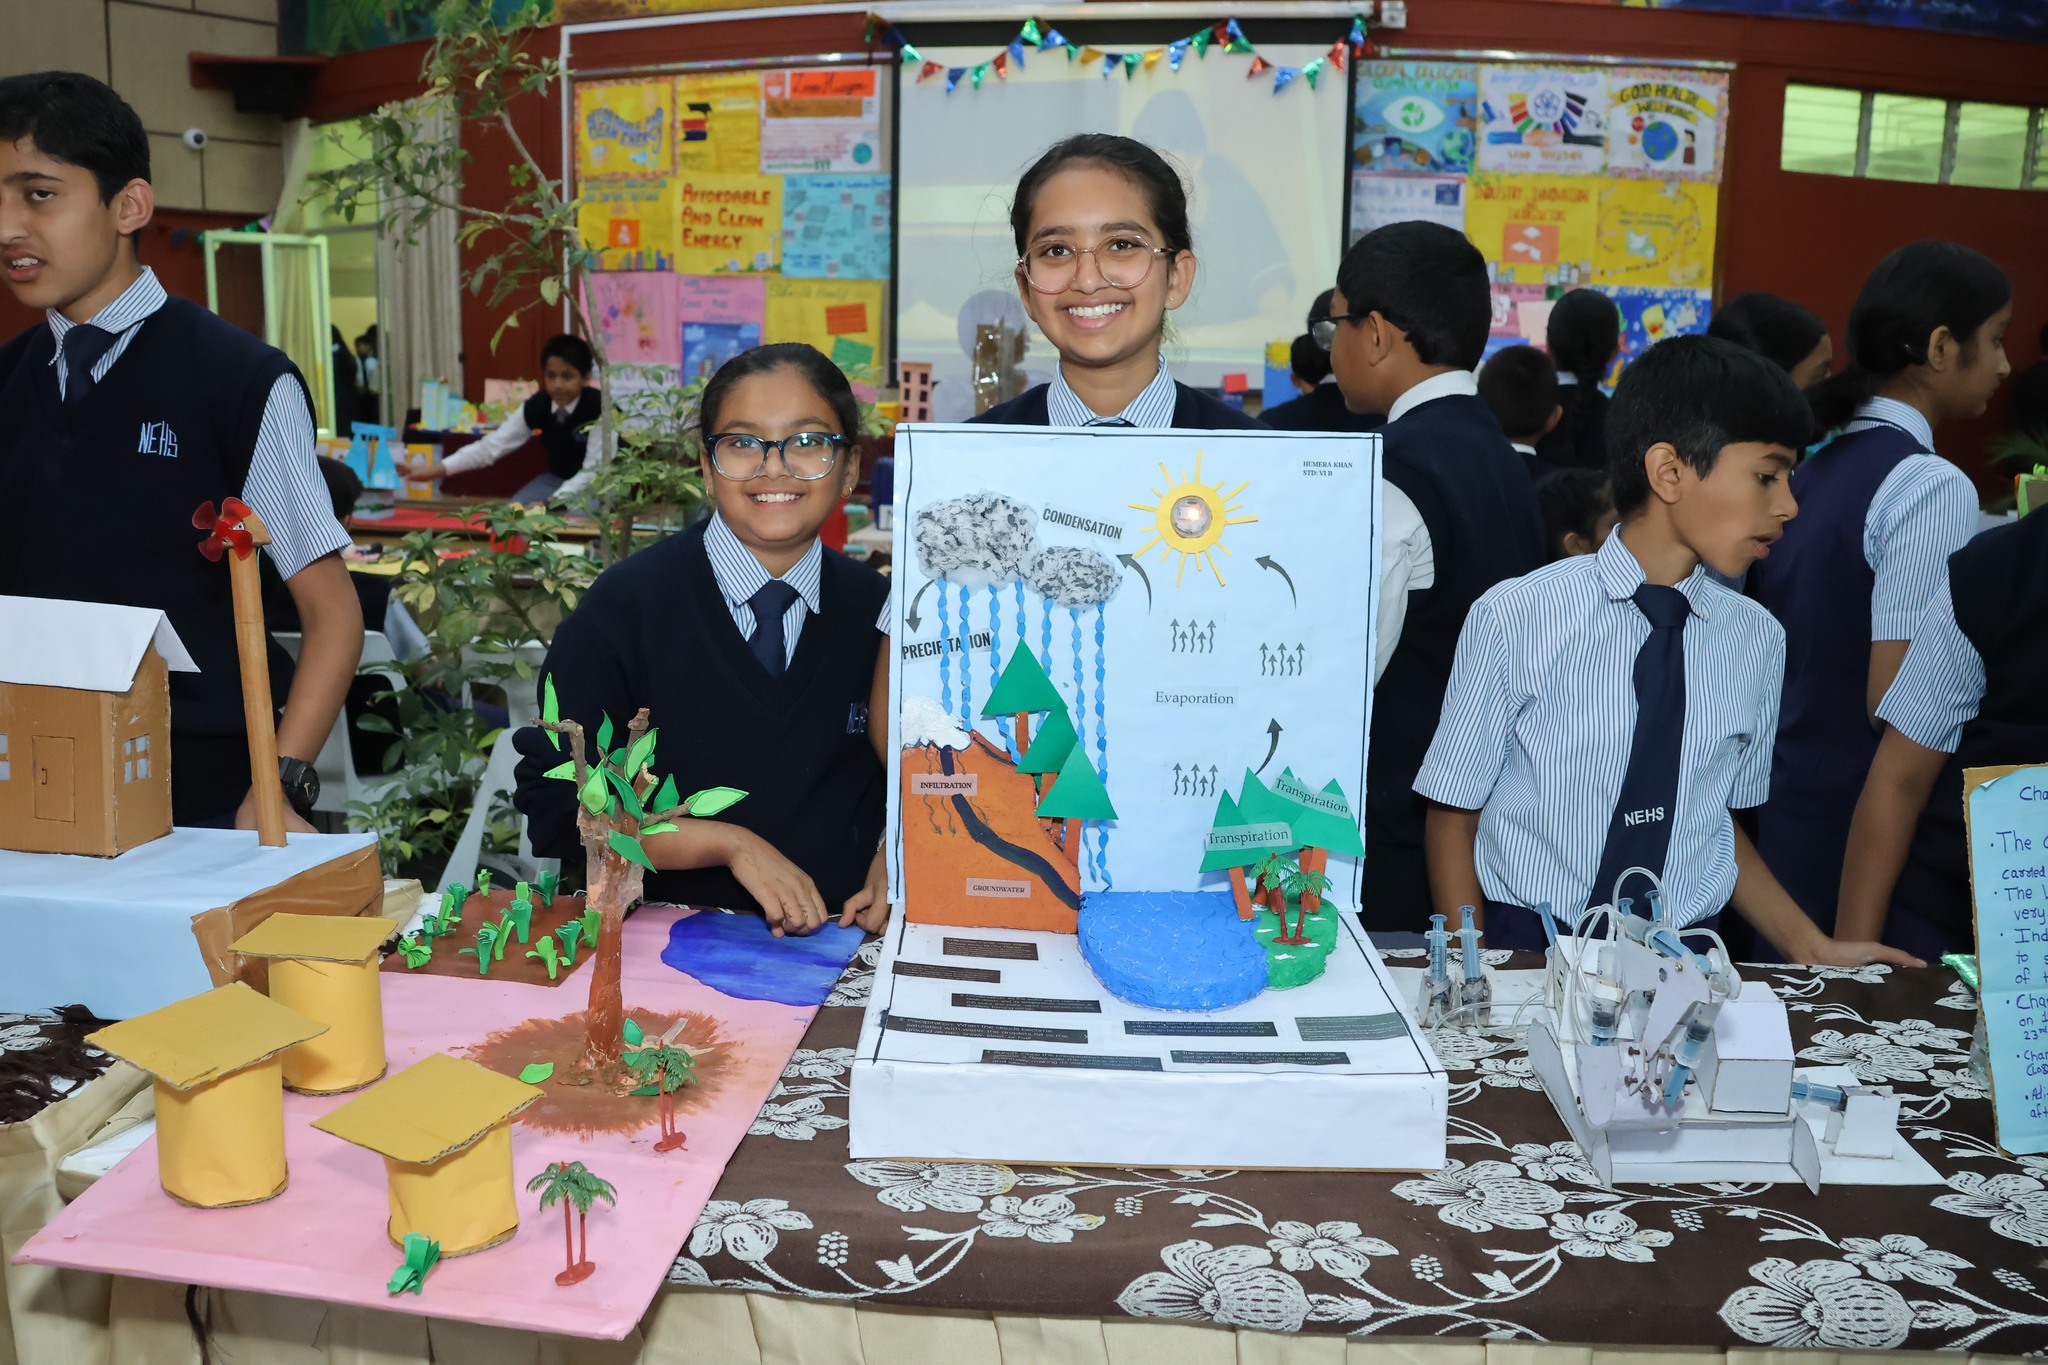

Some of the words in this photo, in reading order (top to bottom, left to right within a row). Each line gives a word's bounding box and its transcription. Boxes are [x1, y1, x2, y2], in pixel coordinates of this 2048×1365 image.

[1620, 83, 1652, 103] GOOD
[681, 183, 770, 206] AFFORDABLE
[681, 205, 712, 226] AND
[718, 207, 764, 228] CLEAN
[682, 228, 743, 250] ENERGY
[138, 420, 179, 458] NEHS
[1043, 508, 1123, 540] CONDENSATION
[902, 632, 991, 660] PRECIPTAION
[1156, 691, 1234, 707] Evaporation
[1276, 778, 1349, 814] Transpiration
[1624, 806, 1665, 828] NEHS
[1208, 829, 1289, 846] Transpiration
[1996, 830, 2032, 853] The
[973, 884, 1025, 893] GROUNDWATER
[2004, 886, 2032, 901] The
[2014, 907, 2046, 925] very
[2016, 950, 2029, 965] to
[2015, 967, 2030, 984] of
[2016, 993, 2048, 1009] Cha
[2019, 1017, 2033, 1027] on
